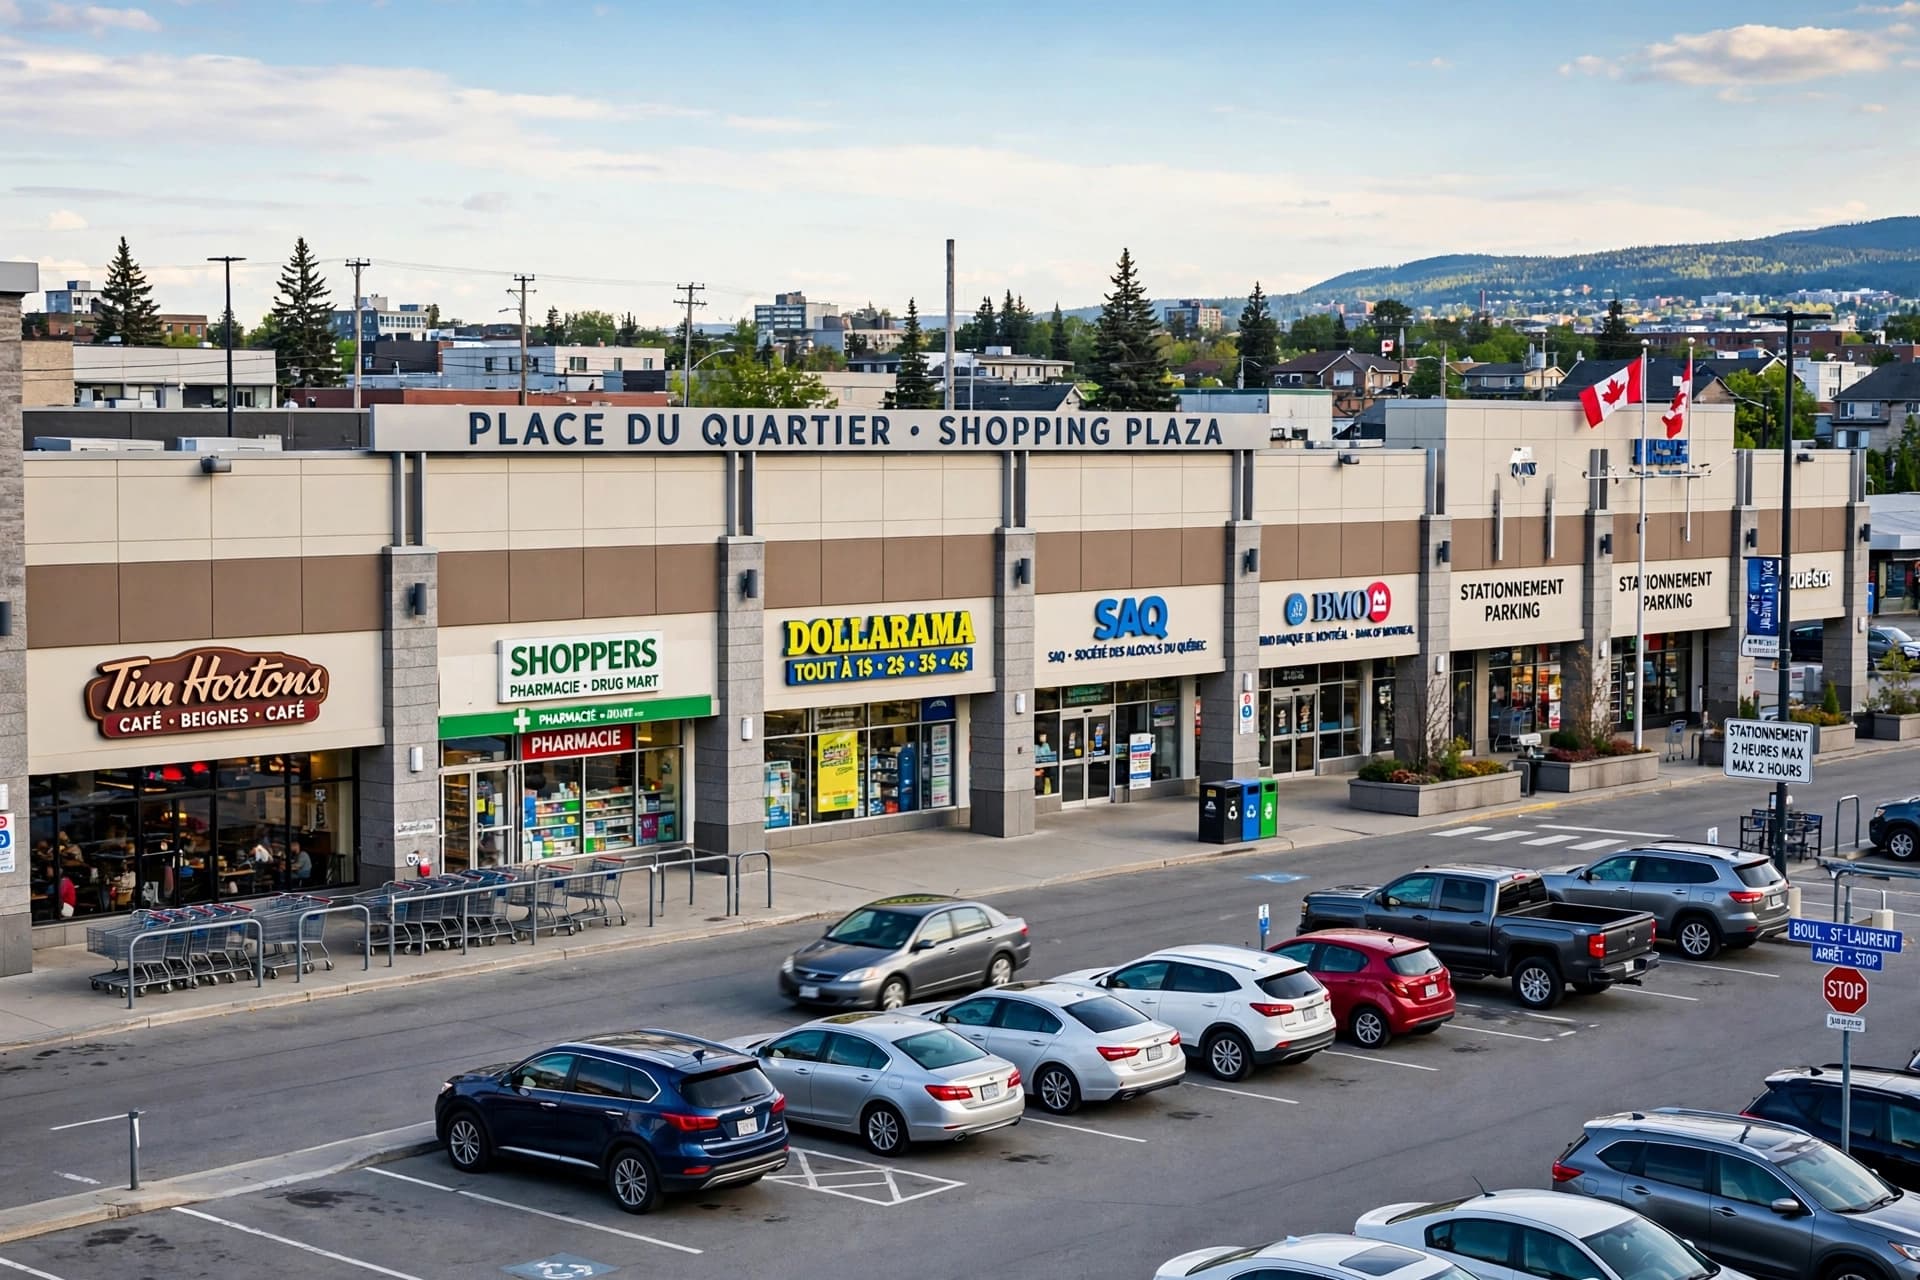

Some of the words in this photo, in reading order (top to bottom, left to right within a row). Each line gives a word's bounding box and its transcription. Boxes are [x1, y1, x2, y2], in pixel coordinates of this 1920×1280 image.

[470, 412, 604, 445] PLACE
[627, 413, 680, 445] DU
[702, 413, 890, 447] QUARTIER
[939, 415, 1110, 445] SHOPPING
[1126, 417, 1223, 445] PLAZA
[1461, 578, 1564, 600] STATIONNEMENT
[1619, 571, 1712, 592] STAIONNEMENT
[1311, 589, 1370, 622] BMO
[1485, 602, 1540, 622] PARKING
[1643, 593, 1693, 611] PARKING
[1094, 595, 1168, 640] SAQ
[784, 610, 976, 656] DOLLARAMA
[511, 638, 658, 677] SHOPPERS
[1048, 650, 1065, 663] SAQ
[1074, 645, 1108, 661] SOCIÉTÉ
[1109, 646, 1125, 658] DES
[1126, 642, 1163, 657] ALCOOLS
[1164, 641, 1175, 654] DU
[1177, 638, 1207, 654] QUÉBEC
[795, 661, 837, 681] TOUT
[841, 656, 852, 678] À
[856, 658, 873, 677] 1$
[887, 655, 905, 675] 2$
[918, 652, 936, 673] 3$
[949, 650, 968, 671] 4$
[102, 659, 174, 711] Tim
[183, 655, 322, 704] Hortons
[510, 680, 580, 698] PHARMACIE
[591, 677, 623, 692] DRUG
[627, 675, 659, 688] MART
[119, 711, 161, 733] CAFÉ
[181, 708, 249, 729] BEIGNES
[266, 700, 305, 721] CAFÉ
[531, 730, 621, 754] PHARMACIE
[1729, 724, 1808, 743] STATIONNEMENT
[1732, 742, 1738, 754] 2
[1741, 743, 1778, 758] HEURES
[1781, 747, 1804, 760] MAX
[1732, 760, 1754, 773] MAX
[1758, 762, 1764, 773] 2
[1767, 762, 1802, 777] HOURS
[1793, 922, 1825, 940] BOUL.
[1830, 927, 1897, 949] ST-LAURENT
[1815, 946, 1843, 962] ARRÊT
[1855, 952, 1878, 967] STOP
[1827, 980, 1863, 1000] STOP
